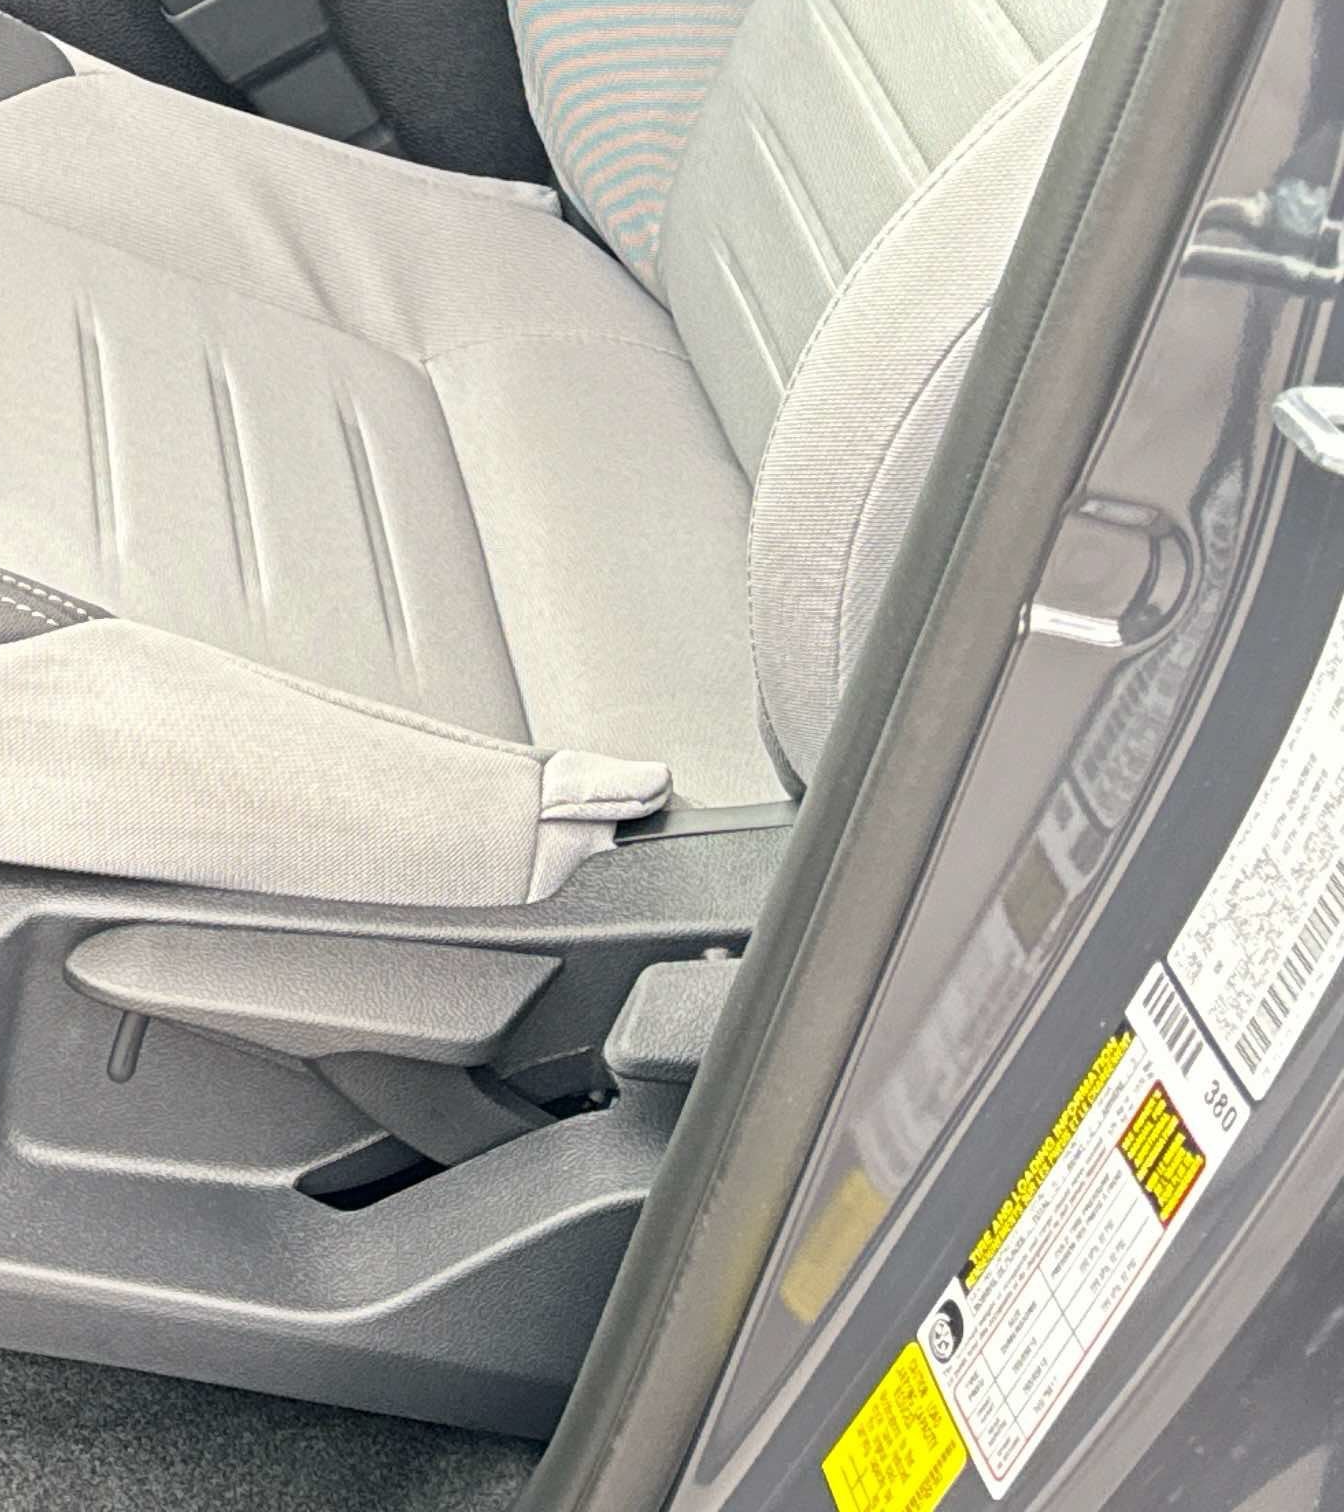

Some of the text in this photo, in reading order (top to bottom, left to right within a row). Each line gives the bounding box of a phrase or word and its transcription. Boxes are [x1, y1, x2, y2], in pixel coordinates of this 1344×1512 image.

[969, 1034, 1119, 1267] TIRE AND LOADING INFORMATION
[1204, 1079, 1237, 1132] 380
